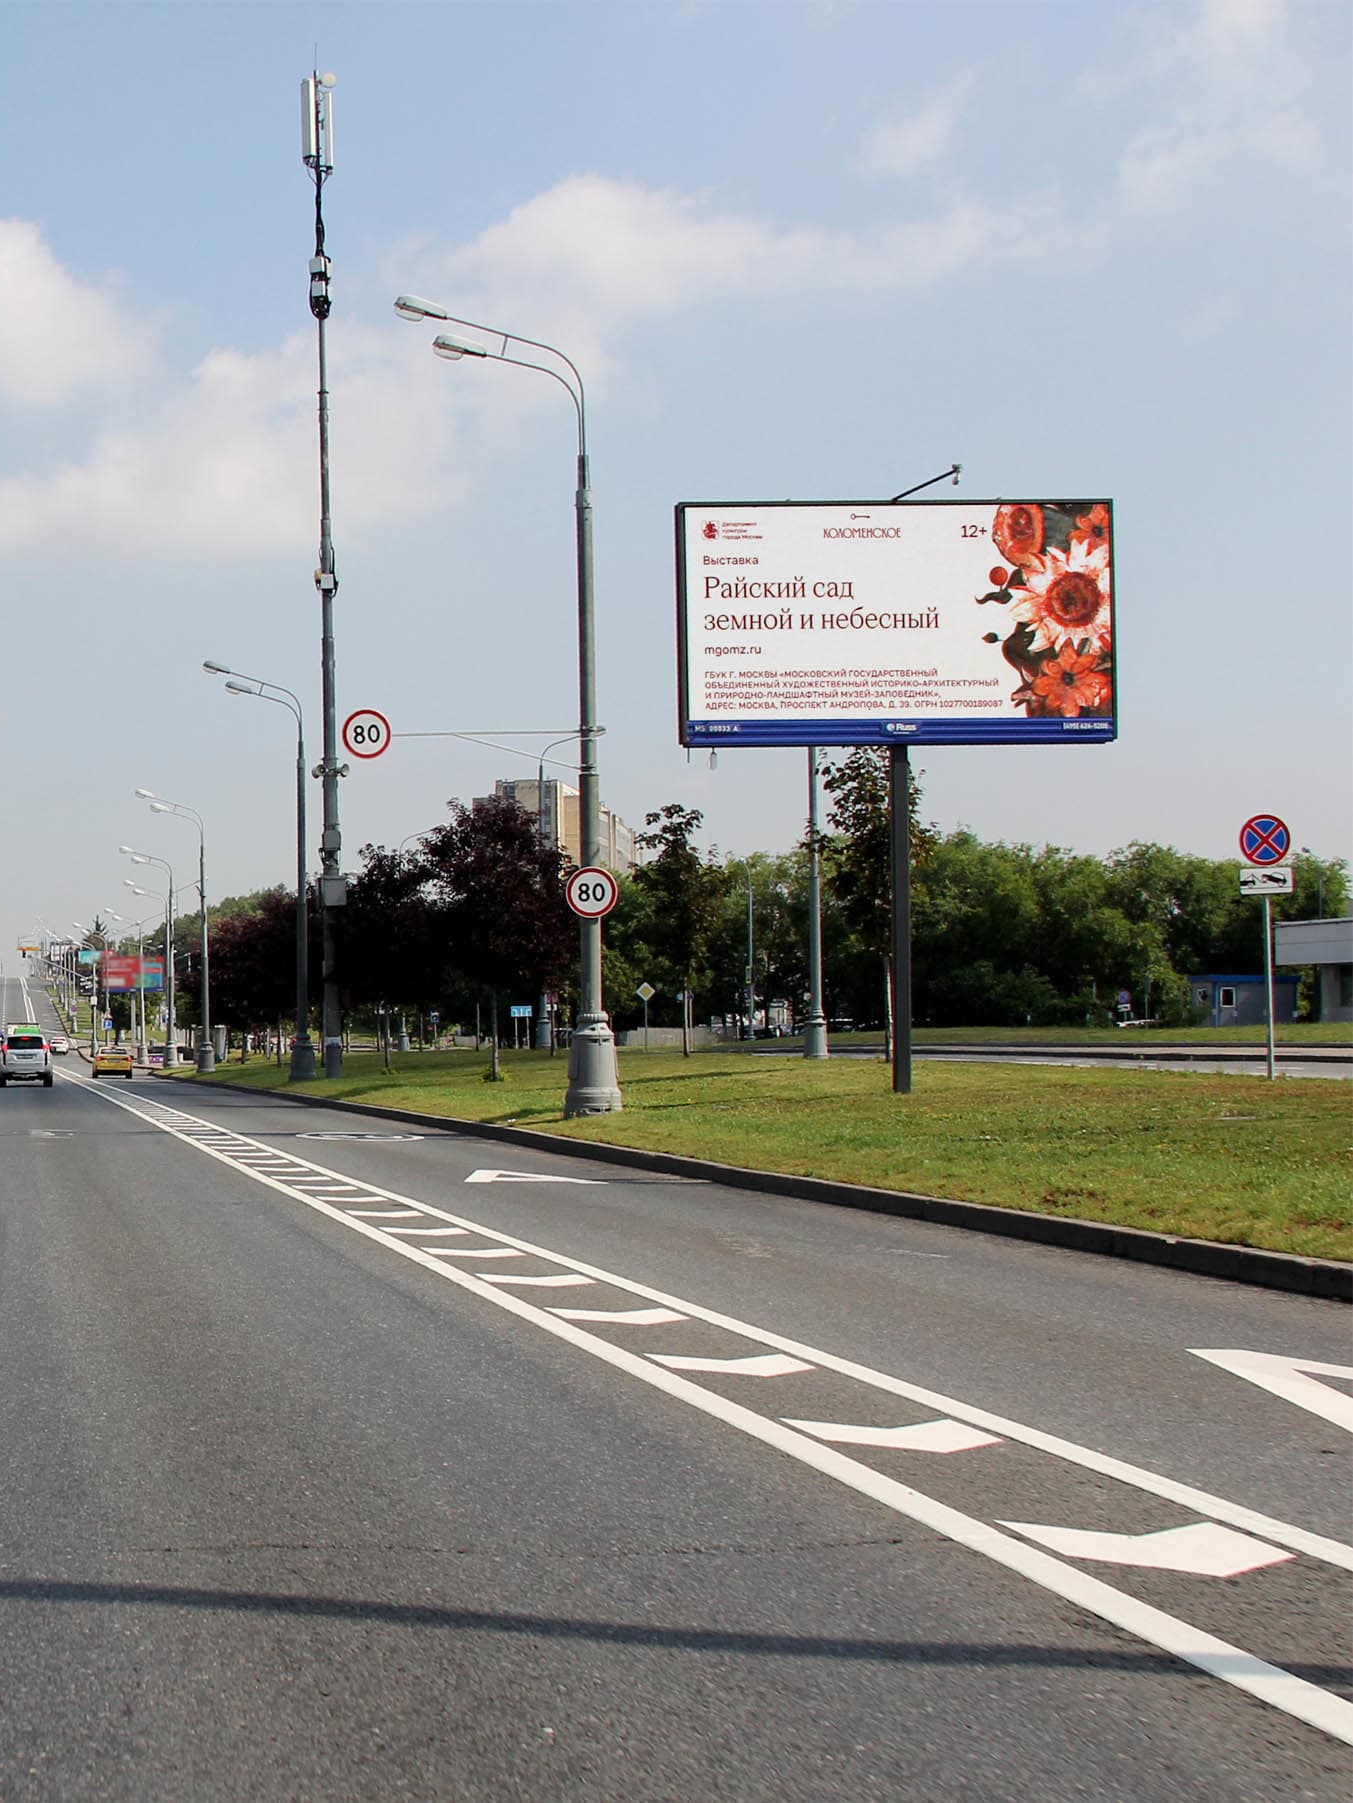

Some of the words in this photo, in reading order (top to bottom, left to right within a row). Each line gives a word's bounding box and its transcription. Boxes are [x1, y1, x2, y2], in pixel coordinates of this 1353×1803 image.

[823, 527, 901, 539] КОЛОМЕНСКОЕ
[961, 525, 987, 538] 12+
[703, 555, 759, 566] Выставка
[704, 576, 806, 599] Райский
[812, 581, 854, 600] сад
[704, 608, 793, 630] земной
[800, 614, 814, 629] и
[821, 606, 939, 629] небесный
[704, 645, 762, 657] mgomz.ru
[705, 671, 726, 679] ГБУК
[739, 670, 777, 678] МОСКВЫ
[779, 668, 847, 678] «МОСКОВСКИЙ
[848, 669, 938, 678] ГОСУДАРСТВЕННЫЙ
[705, 679, 780, 689] ОБЪЕДИНЕННЫЙ
[782, 679, 869, 689] ХУДОЖЕСТВЕННЫЙ
[870, 679, 999, 688] ИСТОРИКО-АРХИТЕКТУРНЫЙ
[714, 690, 838, 700] ПРИРОДНО-ЛАНДШАФТНЫЙ
[705, 702, 736, 710] АДРЕС:
[739, 702, 778, 710] МОСКВА,
[780, 701, 828, 709] ПРОСПЕКТ
[353, 724, 380, 744] 80
[578, 883, 605, 902] 80
